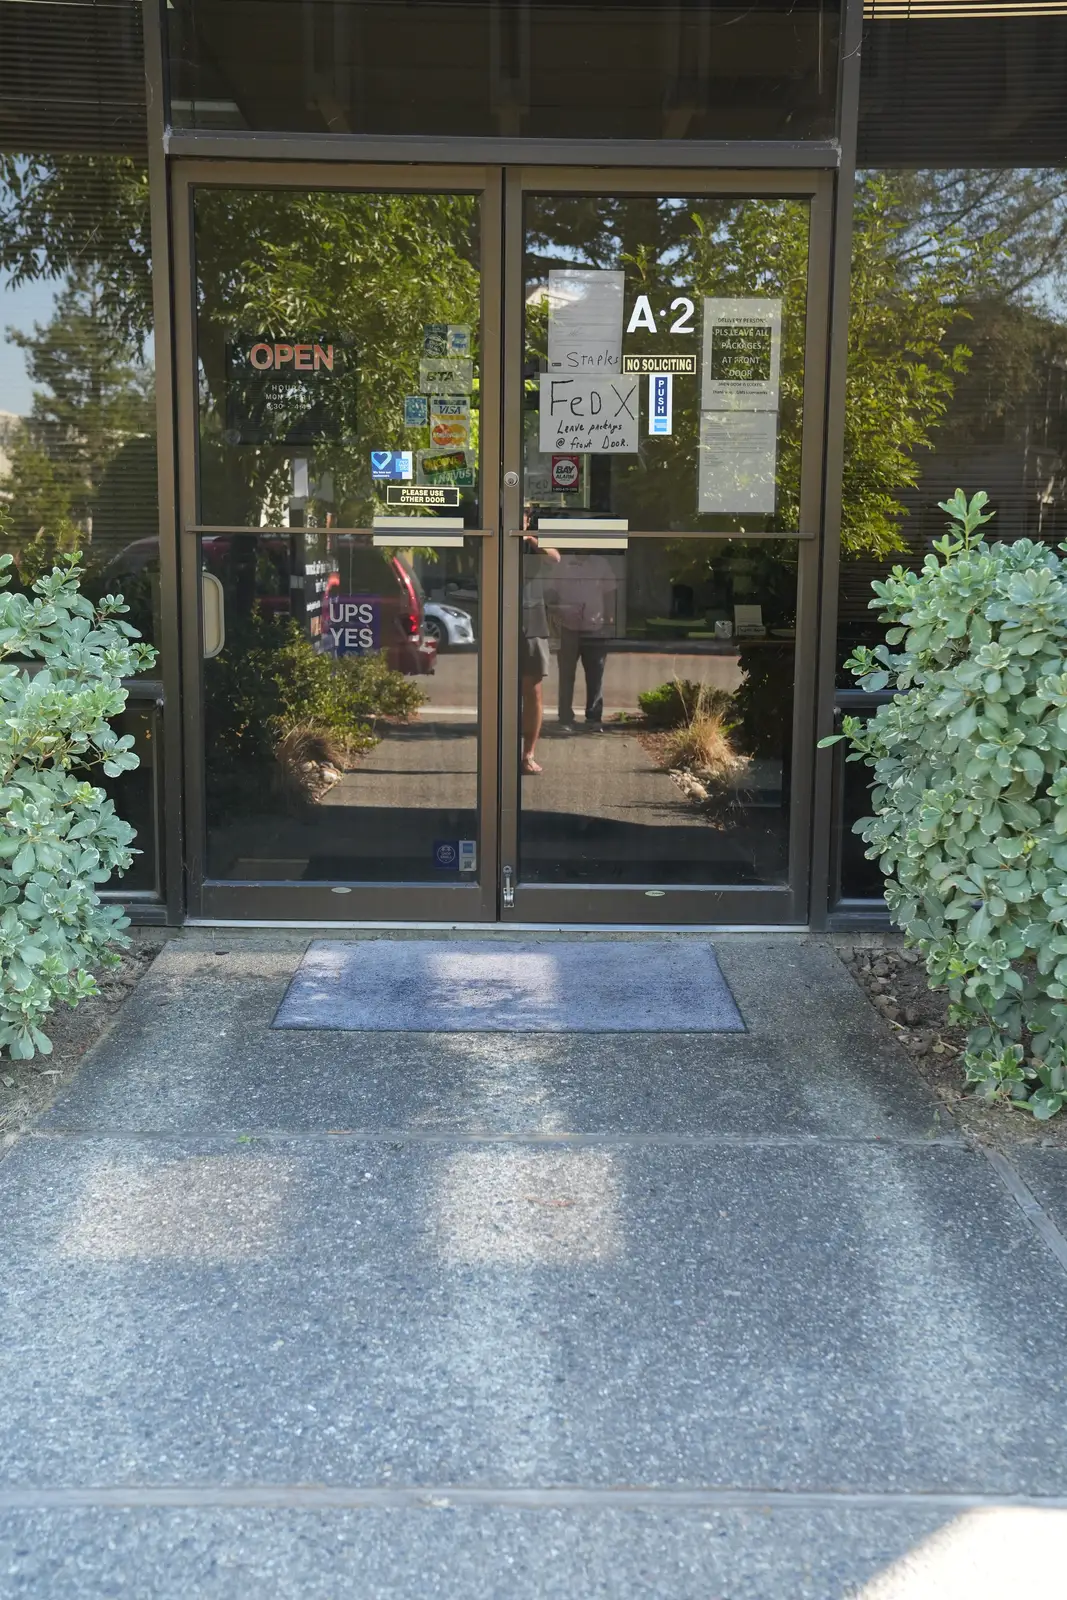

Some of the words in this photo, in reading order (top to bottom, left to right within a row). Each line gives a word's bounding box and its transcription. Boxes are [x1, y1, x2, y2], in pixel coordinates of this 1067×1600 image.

[756, 328, 769, 337] ALL
[721, 342, 762, 350] PACKAGES
[250, 343, 334, 371] OPEN
[722, 356, 733, 364] AT
[734, 356, 760, 364] FRONT
[627, 359, 640, 371] NO
[642, 359, 692, 371] SOLICITING
[728, 369, 753, 377] DOOR
[657, 380, 665, 414] PUSH
[439, 406, 461, 414] VISA
[556, 437, 566, 449] @
[556, 466, 576, 474] BAY
[329, 603, 373, 624] UPS
[329, 628, 374, 648] YES
